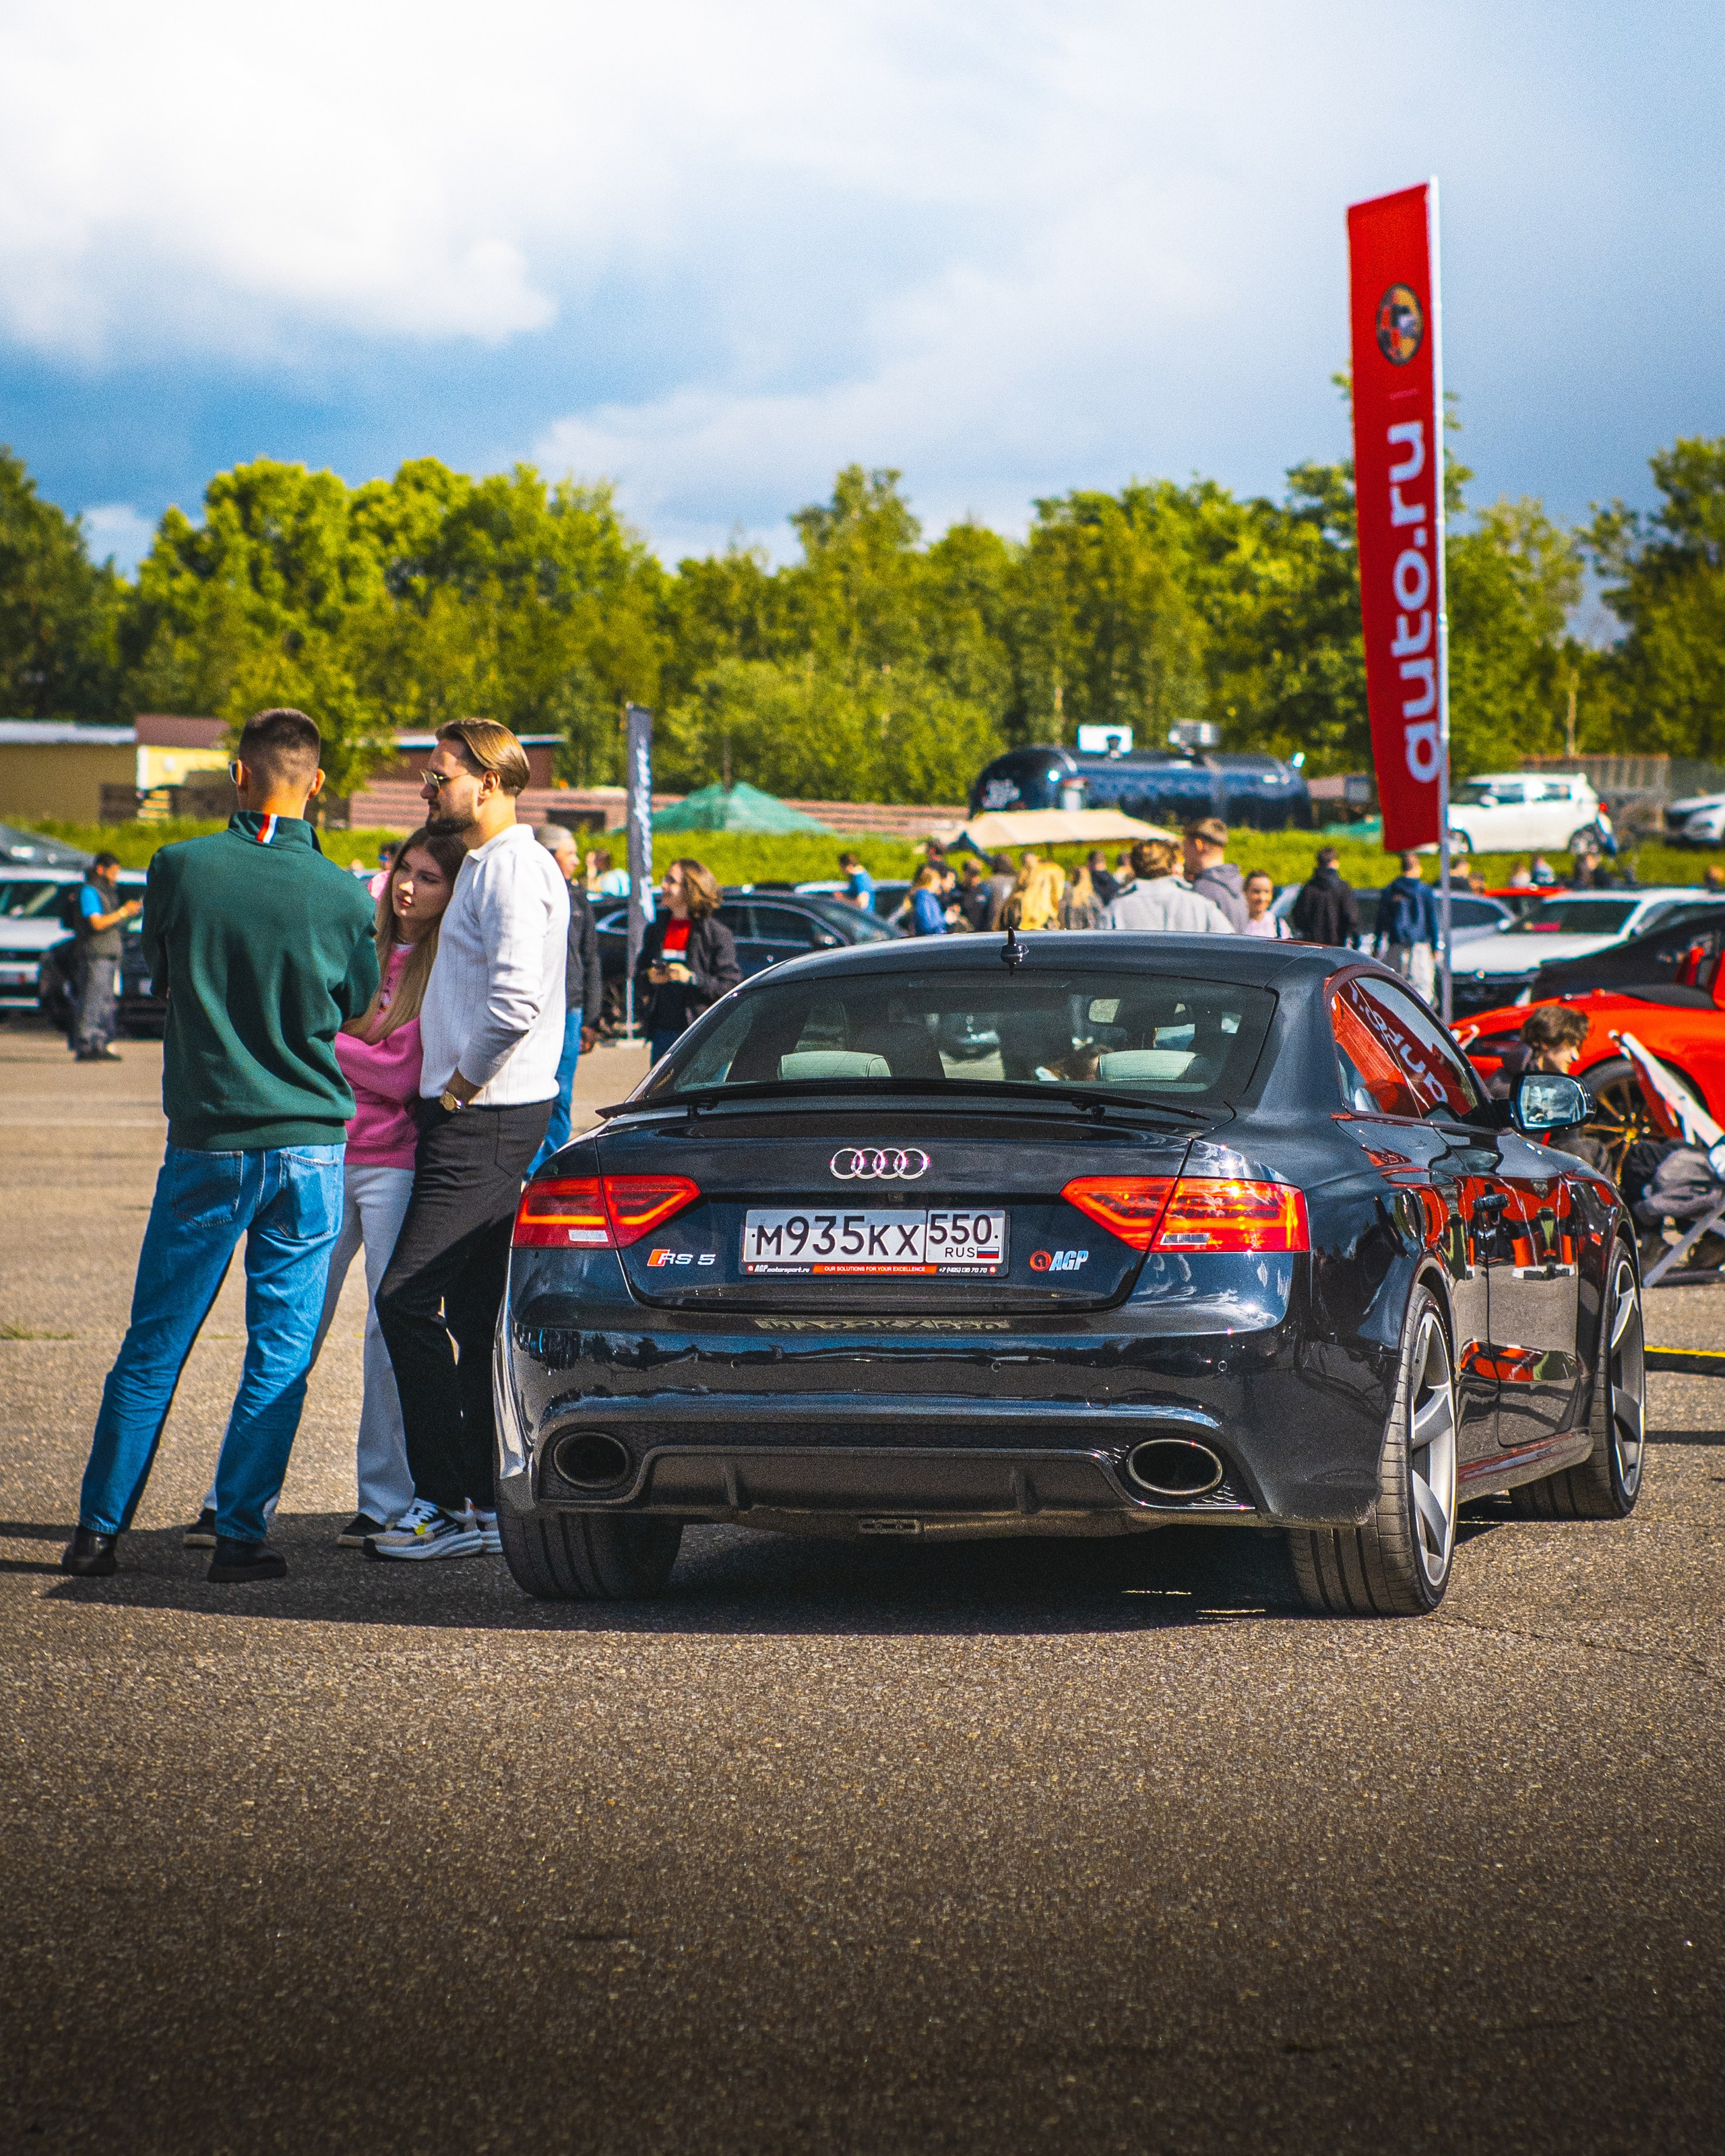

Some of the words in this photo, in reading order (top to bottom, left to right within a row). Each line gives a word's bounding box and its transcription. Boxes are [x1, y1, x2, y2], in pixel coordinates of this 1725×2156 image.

[1387, 420, 1440, 783] auto.ru
[929, 1213, 993, 1244] 550
[654, 1252, 693, 1265] RS
[697, 1254, 716, 1265] 5
[945, 1246, 976, 1258] RUS
[1049, 1250, 1089, 1271] AGP
